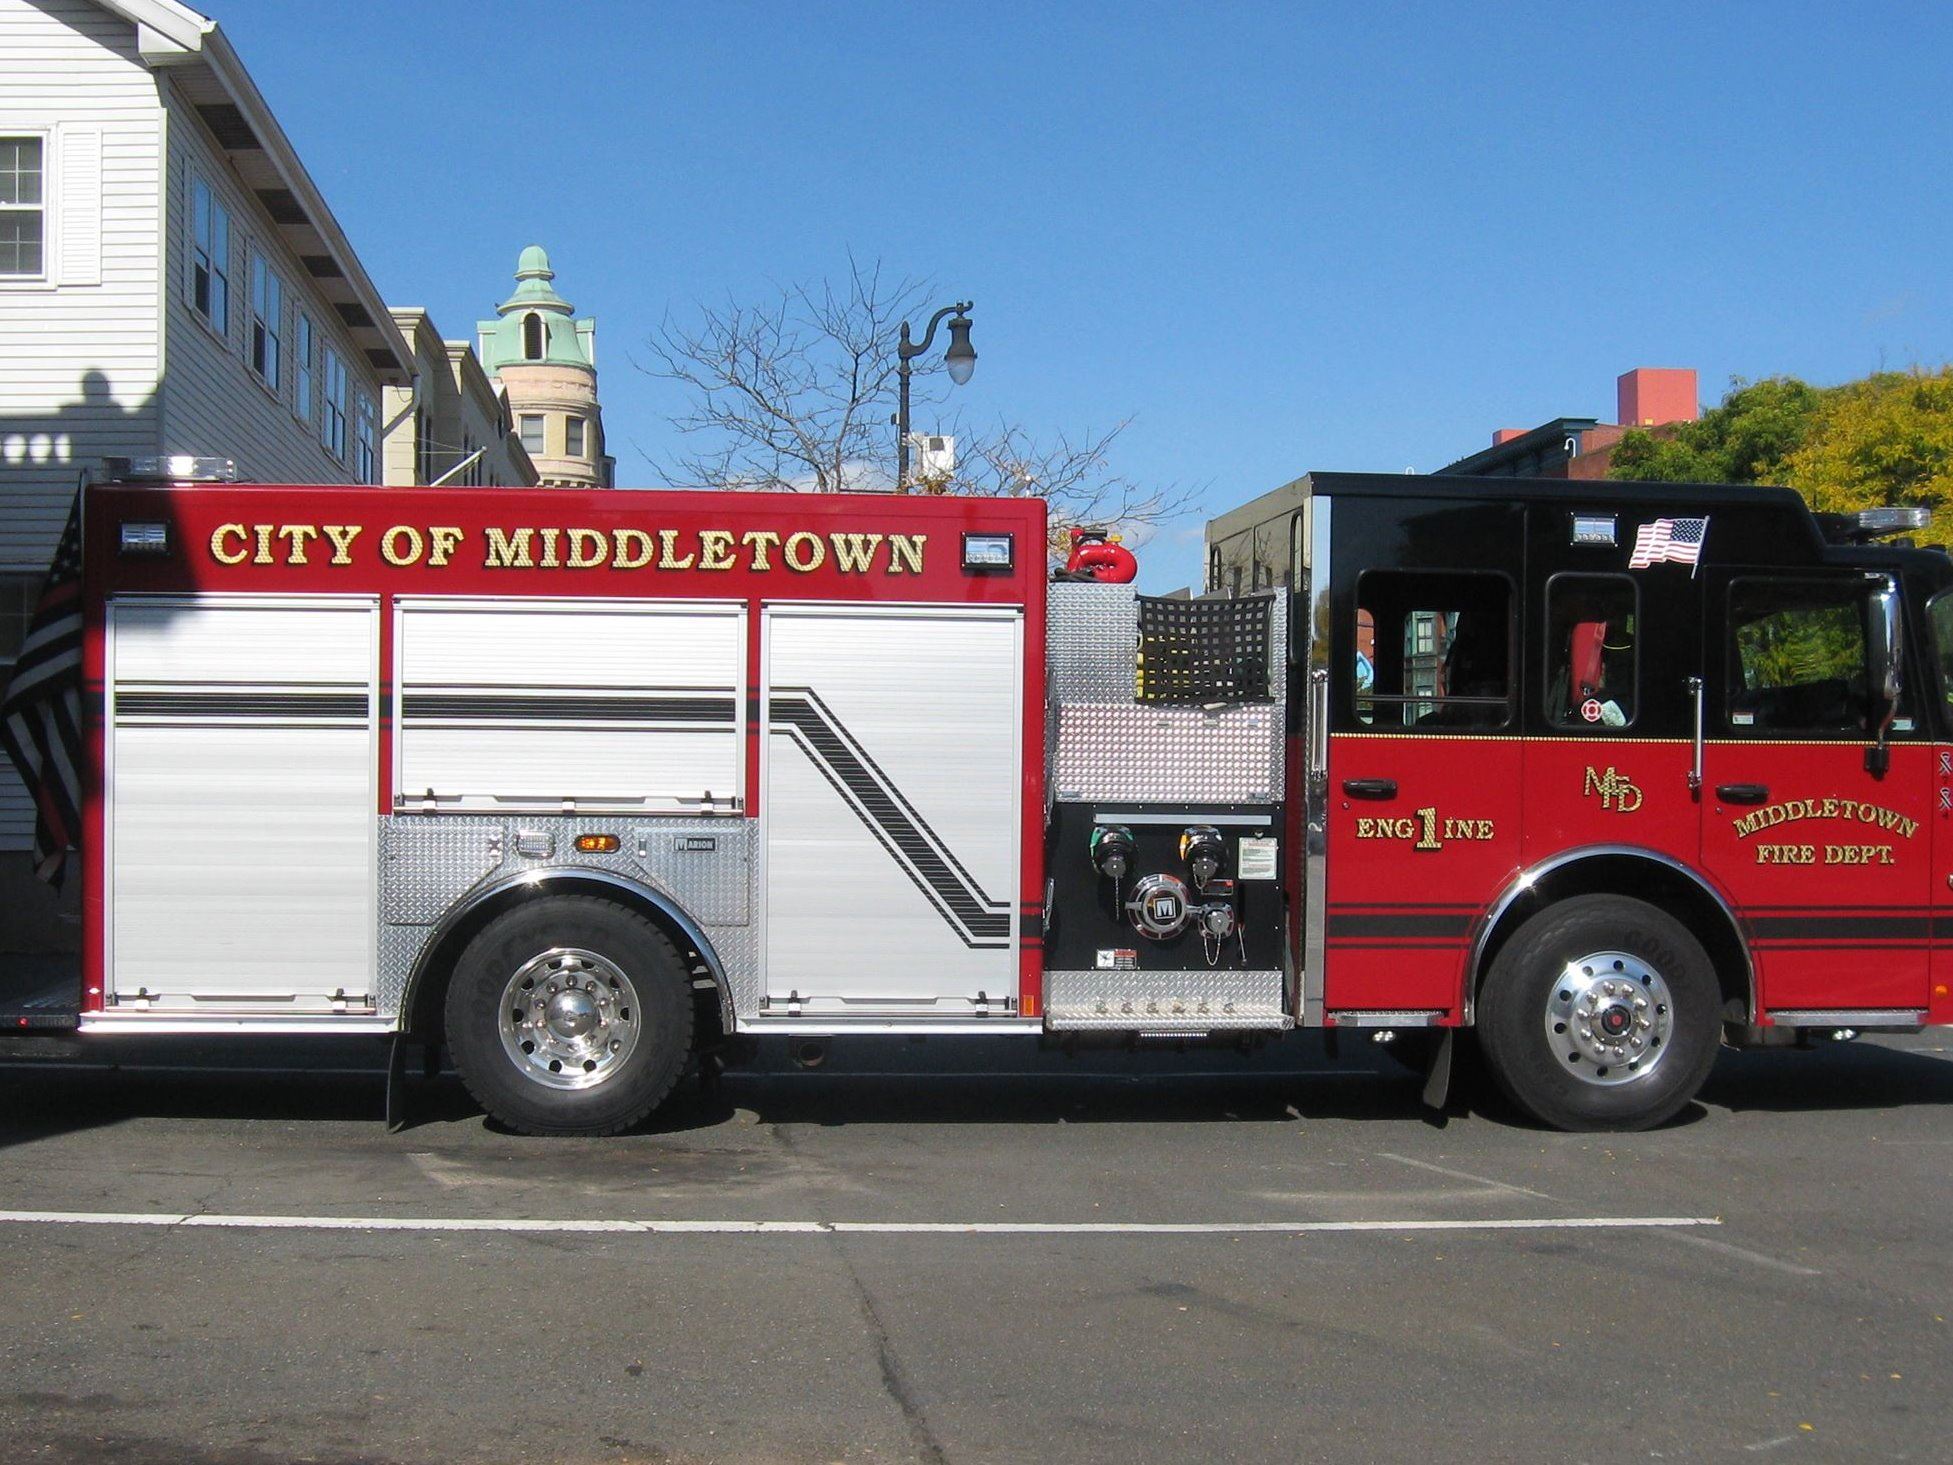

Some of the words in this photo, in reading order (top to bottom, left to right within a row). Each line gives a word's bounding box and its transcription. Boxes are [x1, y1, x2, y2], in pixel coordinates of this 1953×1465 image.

[210, 523, 362, 564] CITY
[381, 525, 464, 566] OF
[484, 527, 928, 573] MIDDLETOWN
[1733, 799, 1919, 839] MIDDLETOWN
[1756, 844, 1815, 864] FIRE
[1824, 845, 1894, 864] DEPT.
